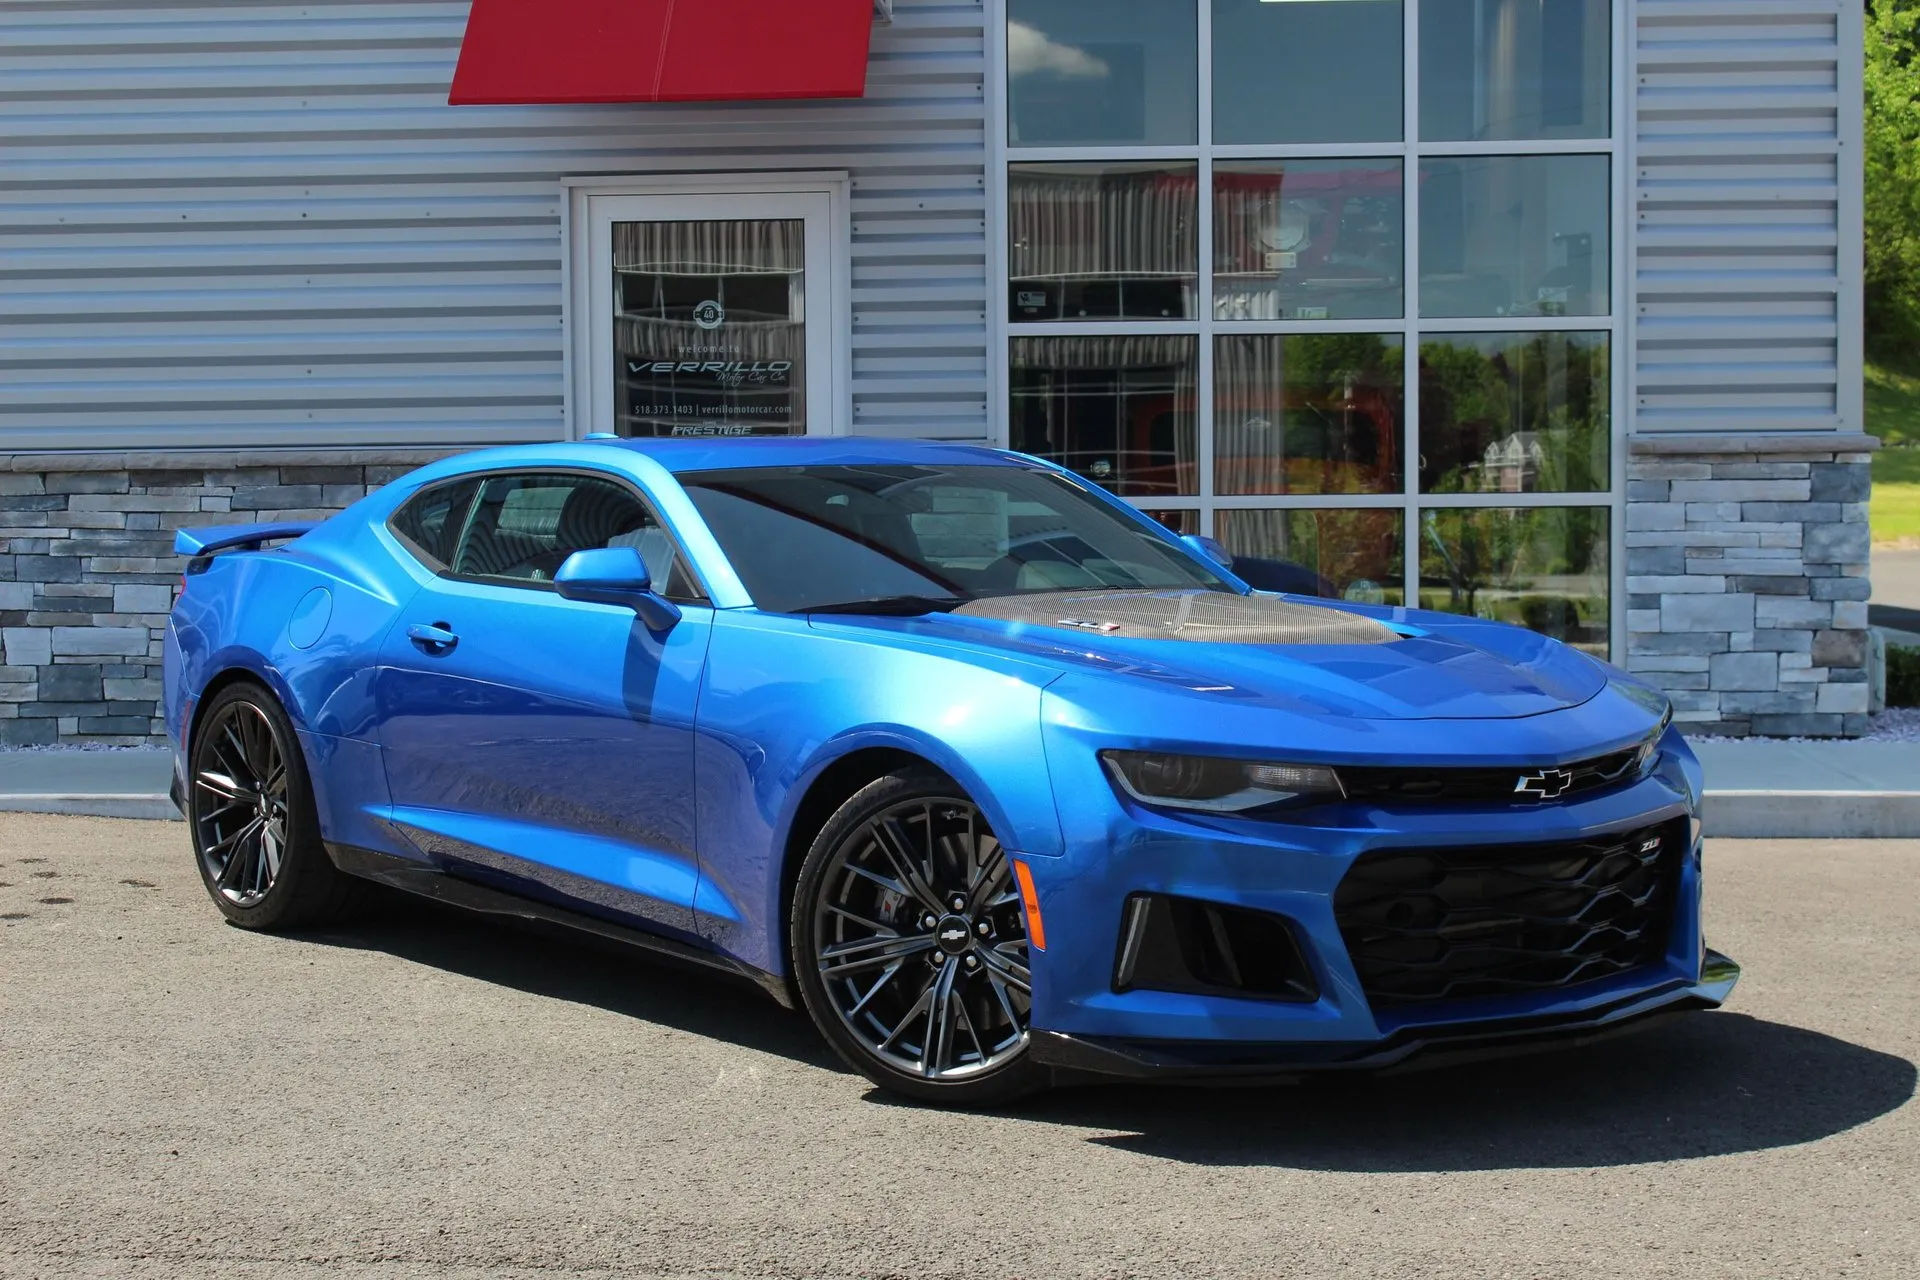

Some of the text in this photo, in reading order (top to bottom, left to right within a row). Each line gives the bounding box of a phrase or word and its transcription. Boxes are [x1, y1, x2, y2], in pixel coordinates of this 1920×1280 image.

[679, 344, 740, 353] welcome to
[629, 361, 792, 373] VERRILLO
[715, 371, 744, 387] Motor
[748, 371, 767, 384] Car
[635, 404, 792, 415] 518.373.1403 verrillomotorcar.com
[671, 425, 752, 436] PRESTIGE
